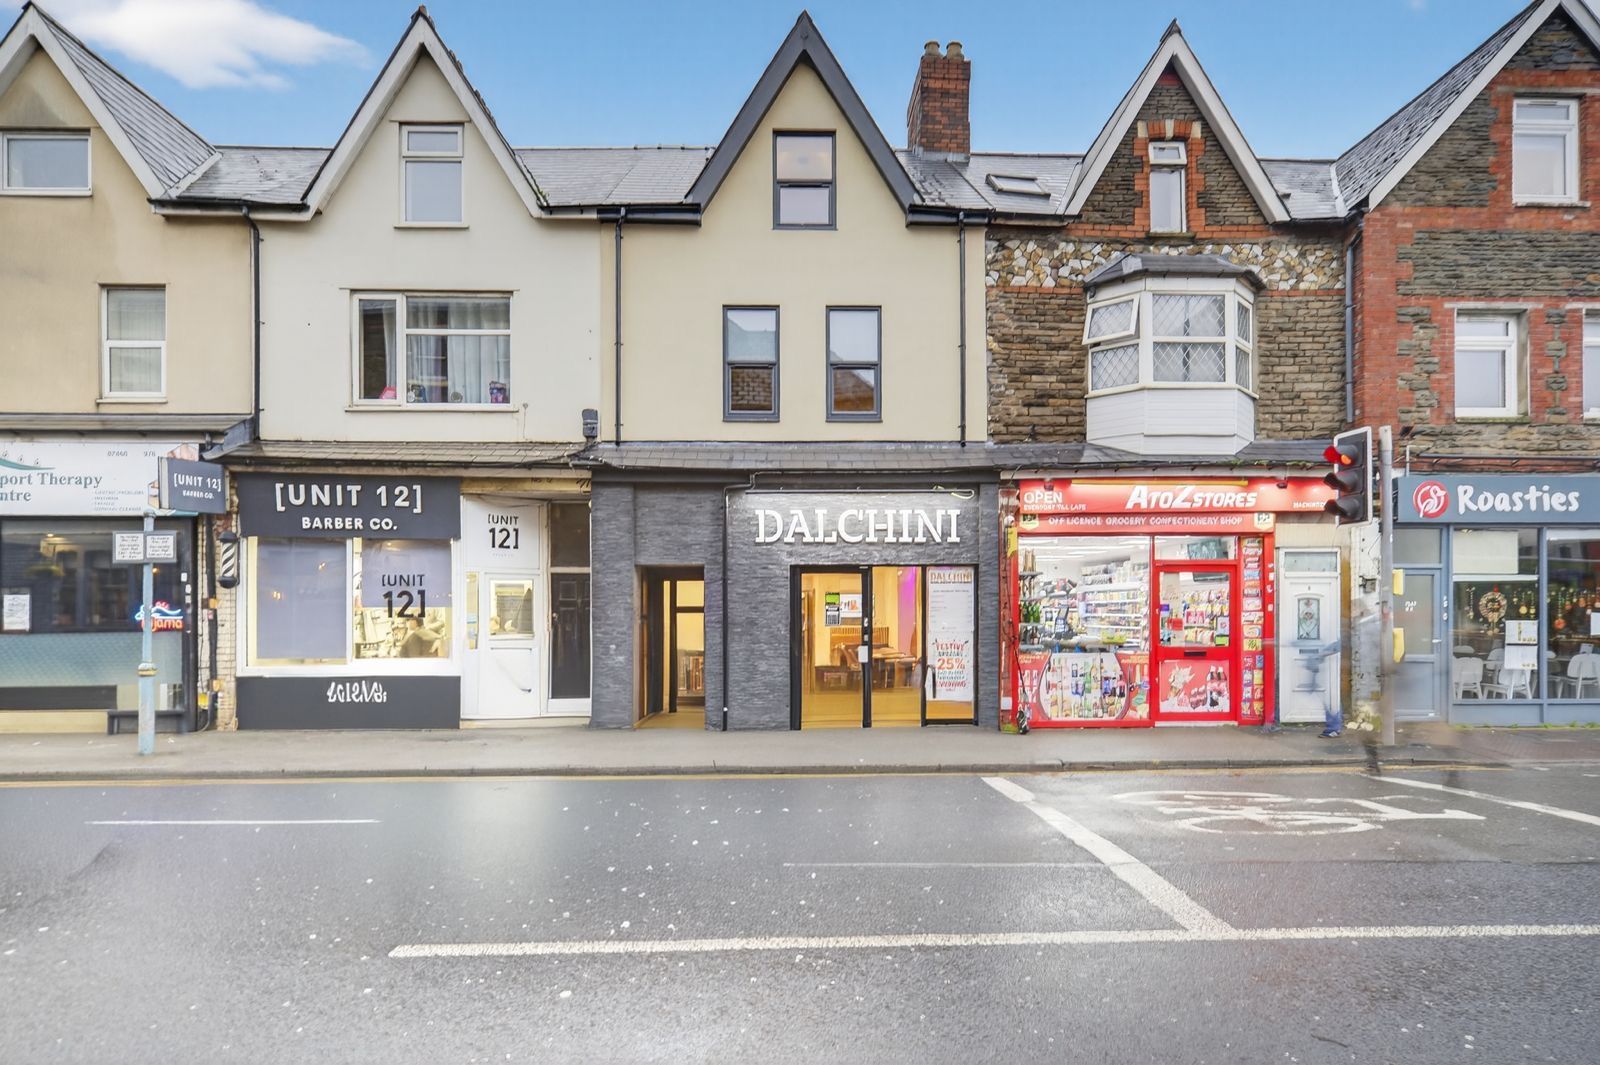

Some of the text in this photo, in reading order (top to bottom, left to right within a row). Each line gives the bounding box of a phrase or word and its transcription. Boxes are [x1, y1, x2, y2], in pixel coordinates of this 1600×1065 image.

[37, 472, 103, 489] Therapy
[173, 472, 221, 492] [UNIT 12]
[275, 482, 422, 514] [UNIT 12]
[1023, 490, 1063, 504] OPEN
[1457, 484, 1580, 515] Roasties
[302, 516, 398, 531] BARBER CO.
[488, 513, 519, 525] [UNIT
[755, 508, 961, 544] DALCHINI
[1105, 516, 1147, 526] GROCERY
[1149, 516, 1219, 526] CONFECTIONERY
[1220, 516, 1243, 525] SHOP
[488, 527, 519, 549] 12]
[381, 574, 425, 587] [UNIT
[382, 589, 426, 618] 12]
[936, 657, 966, 670] 25%
